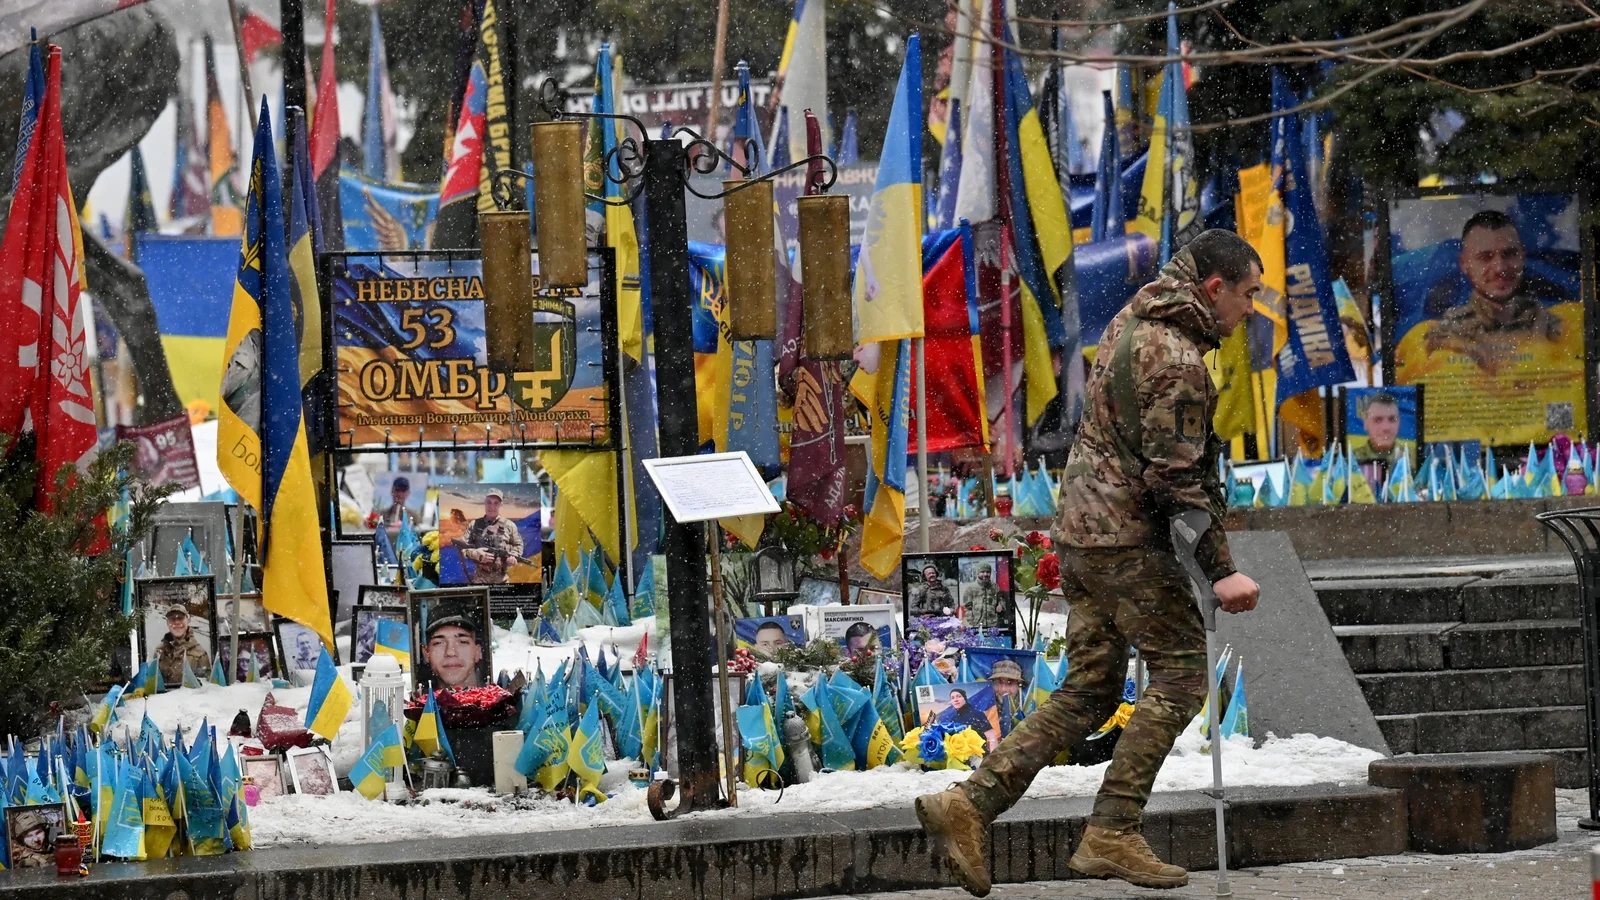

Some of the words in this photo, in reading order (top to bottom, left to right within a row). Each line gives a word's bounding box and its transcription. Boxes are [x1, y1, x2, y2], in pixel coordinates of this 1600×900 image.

[356, 277, 485, 302] НЕБЕСНА
[401, 308, 455, 350] 53
[1286, 263, 1336, 368] РУДИКА
[360, 359, 507, 409] ОМБр
[357, 414, 378, 426] ім.
[380, 415, 422, 426] князя
[426, 412, 514, 426] Володимира
[517, 410, 591, 423] Мономаха
